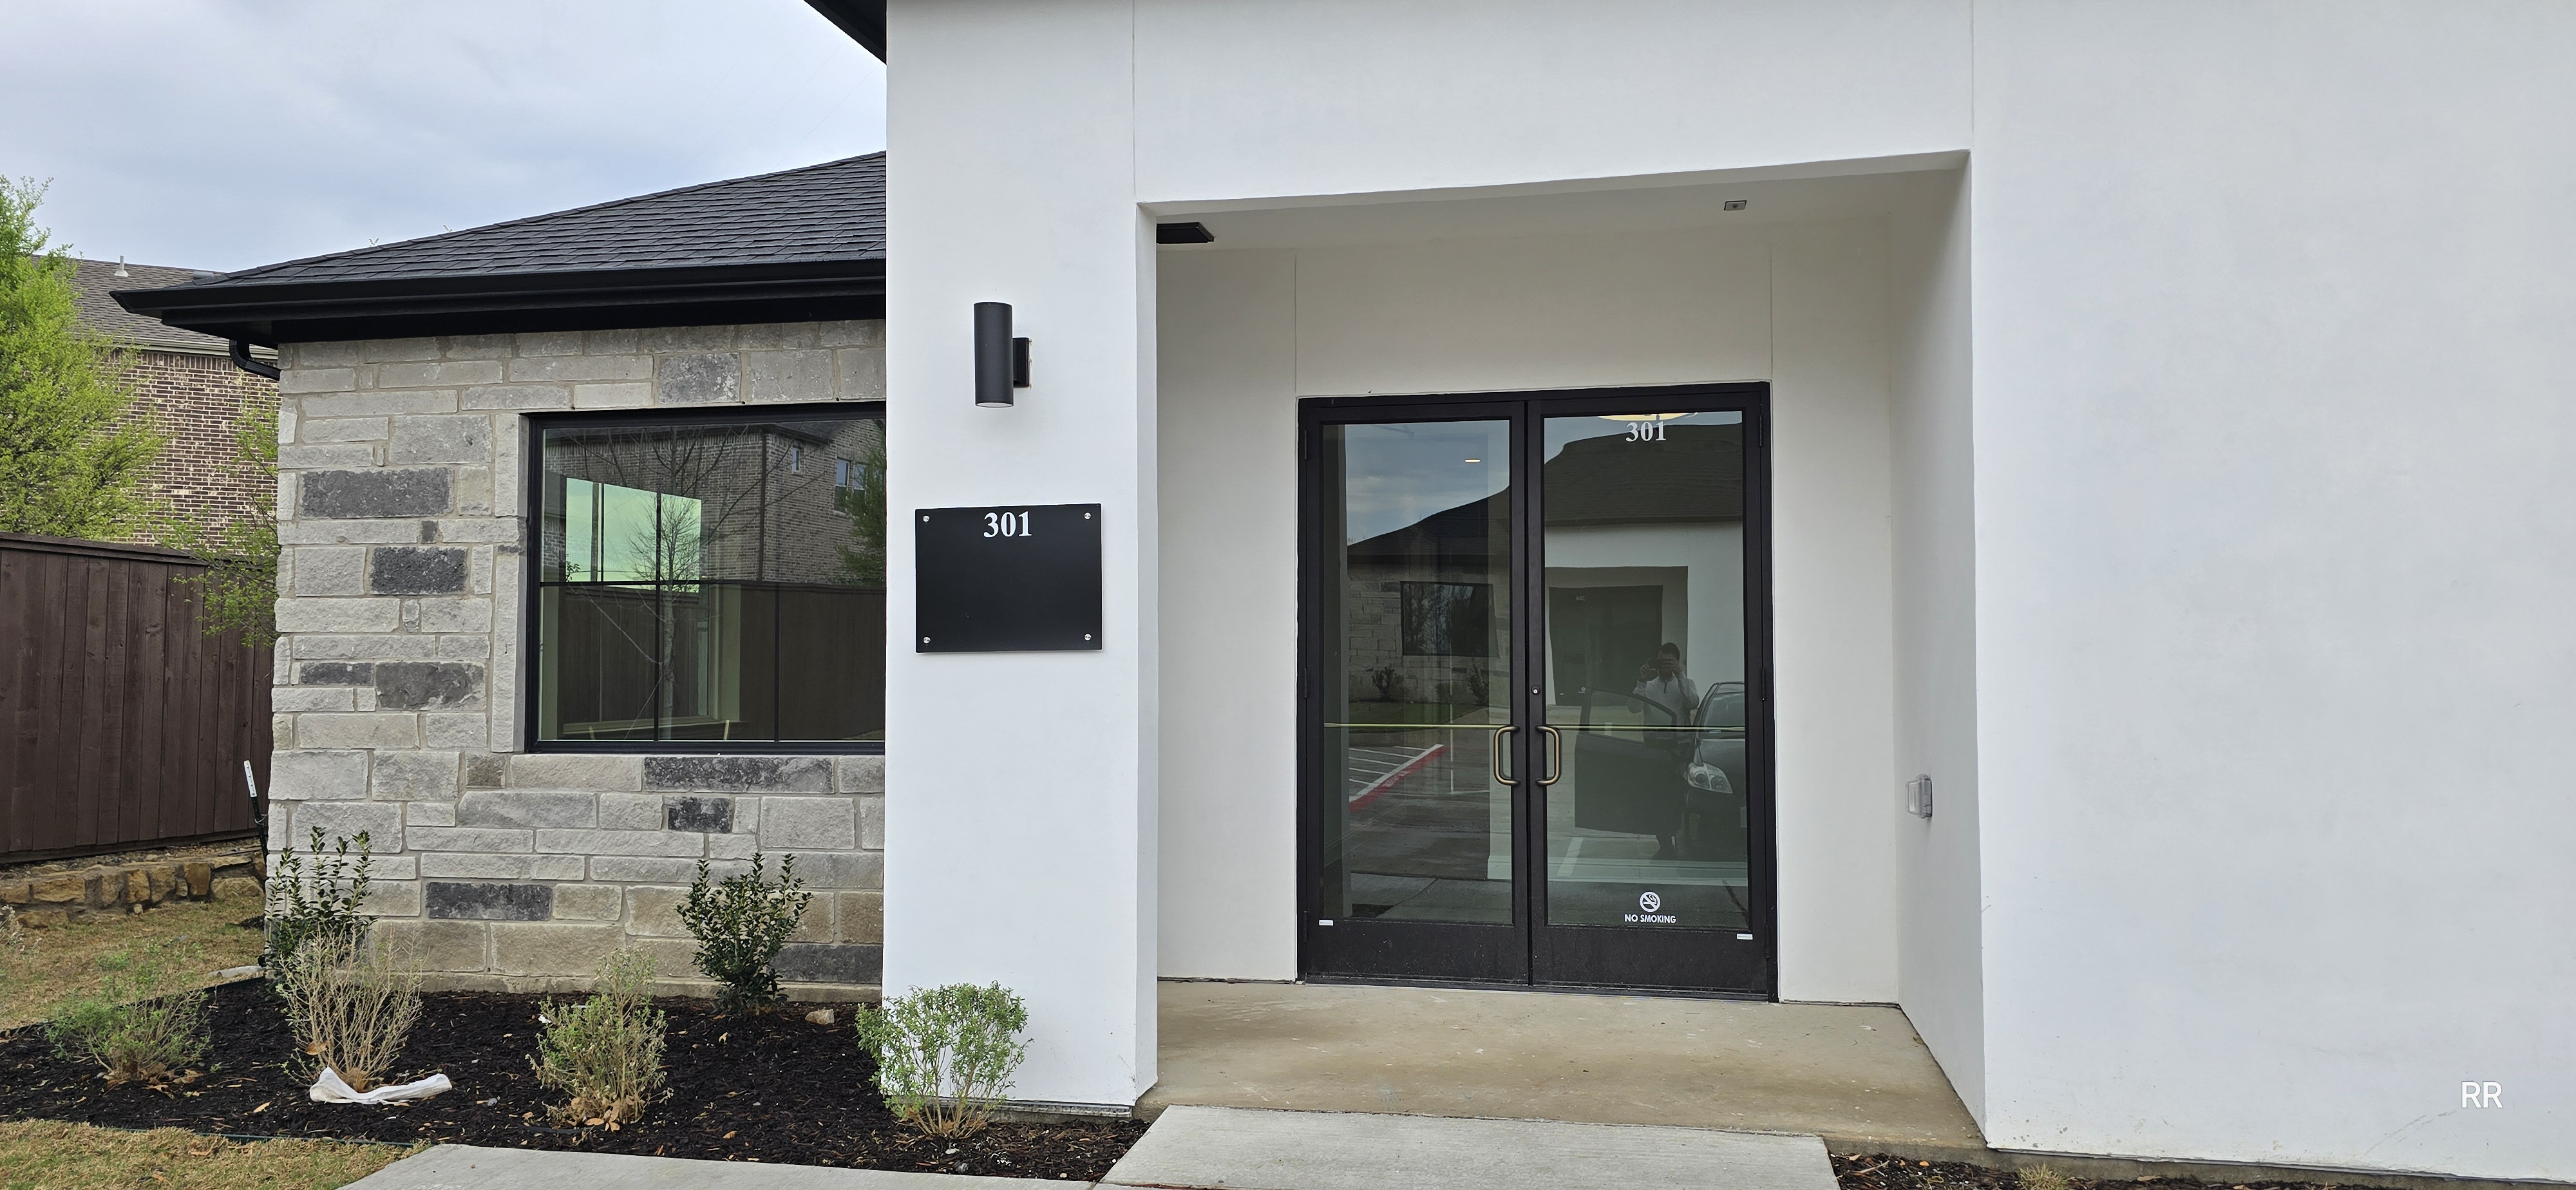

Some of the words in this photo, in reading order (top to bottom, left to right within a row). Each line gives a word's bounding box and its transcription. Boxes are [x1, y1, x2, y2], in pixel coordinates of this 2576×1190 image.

[1625, 420, 1667, 442] 301
[983, 511, 1032, 538] 301
[1624, 914, 1638, 923] NO
[1640, 914, 1676, 923] SMOKING
